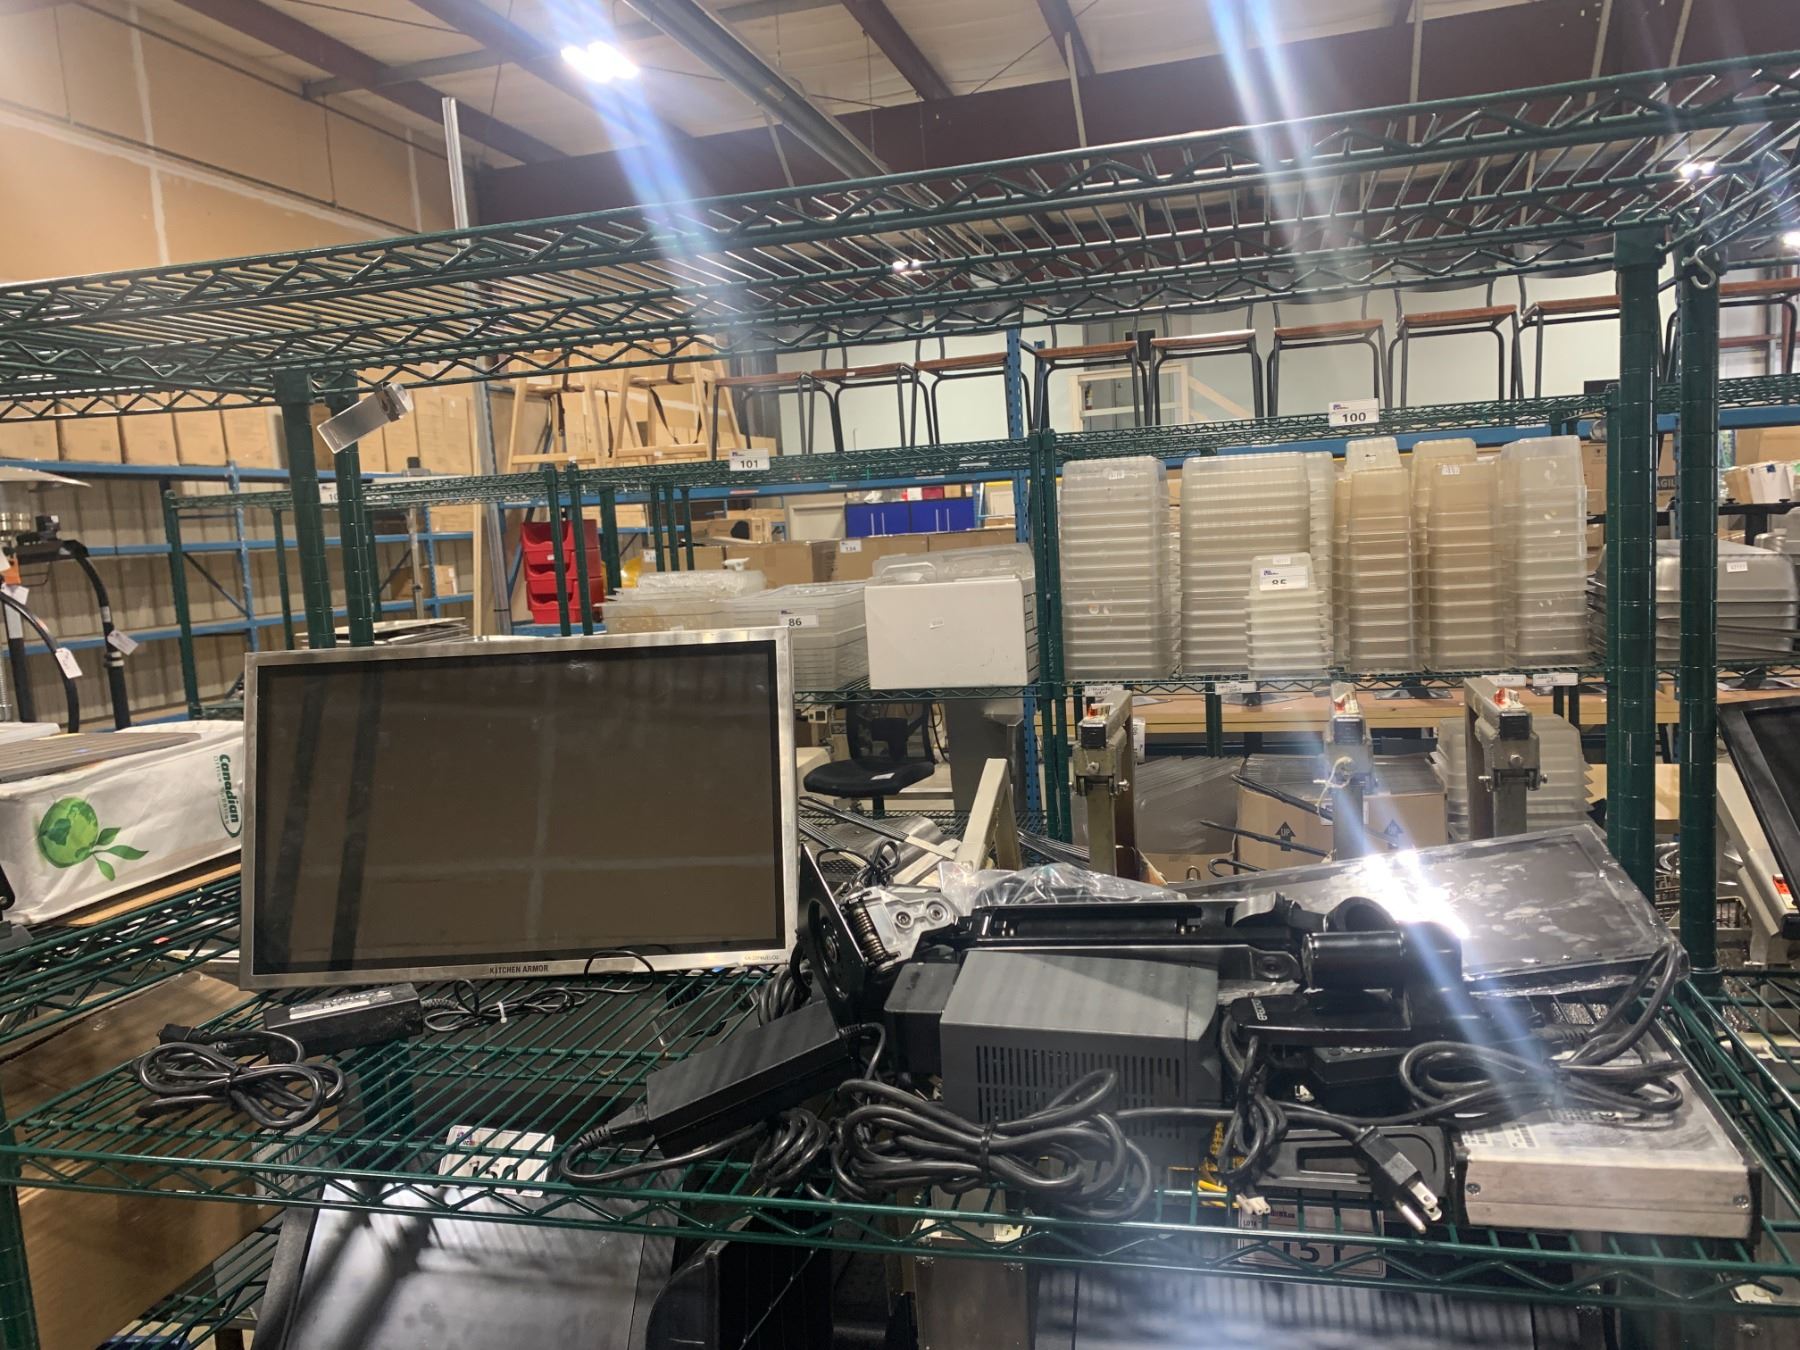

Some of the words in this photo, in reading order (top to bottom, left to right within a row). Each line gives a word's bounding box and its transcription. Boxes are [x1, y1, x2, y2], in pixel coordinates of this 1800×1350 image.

[1342, 412, 1366, 422] 100
[740, 460, 758, 469] 101
[788, 617, 802, 627] 86
[219, 754, 239, 823] Canadian
[1280, 827, 1291, 836] UP
[489, 966, 521, 975] KITCHEN
[522, 964, 549, 973] ARMOR
